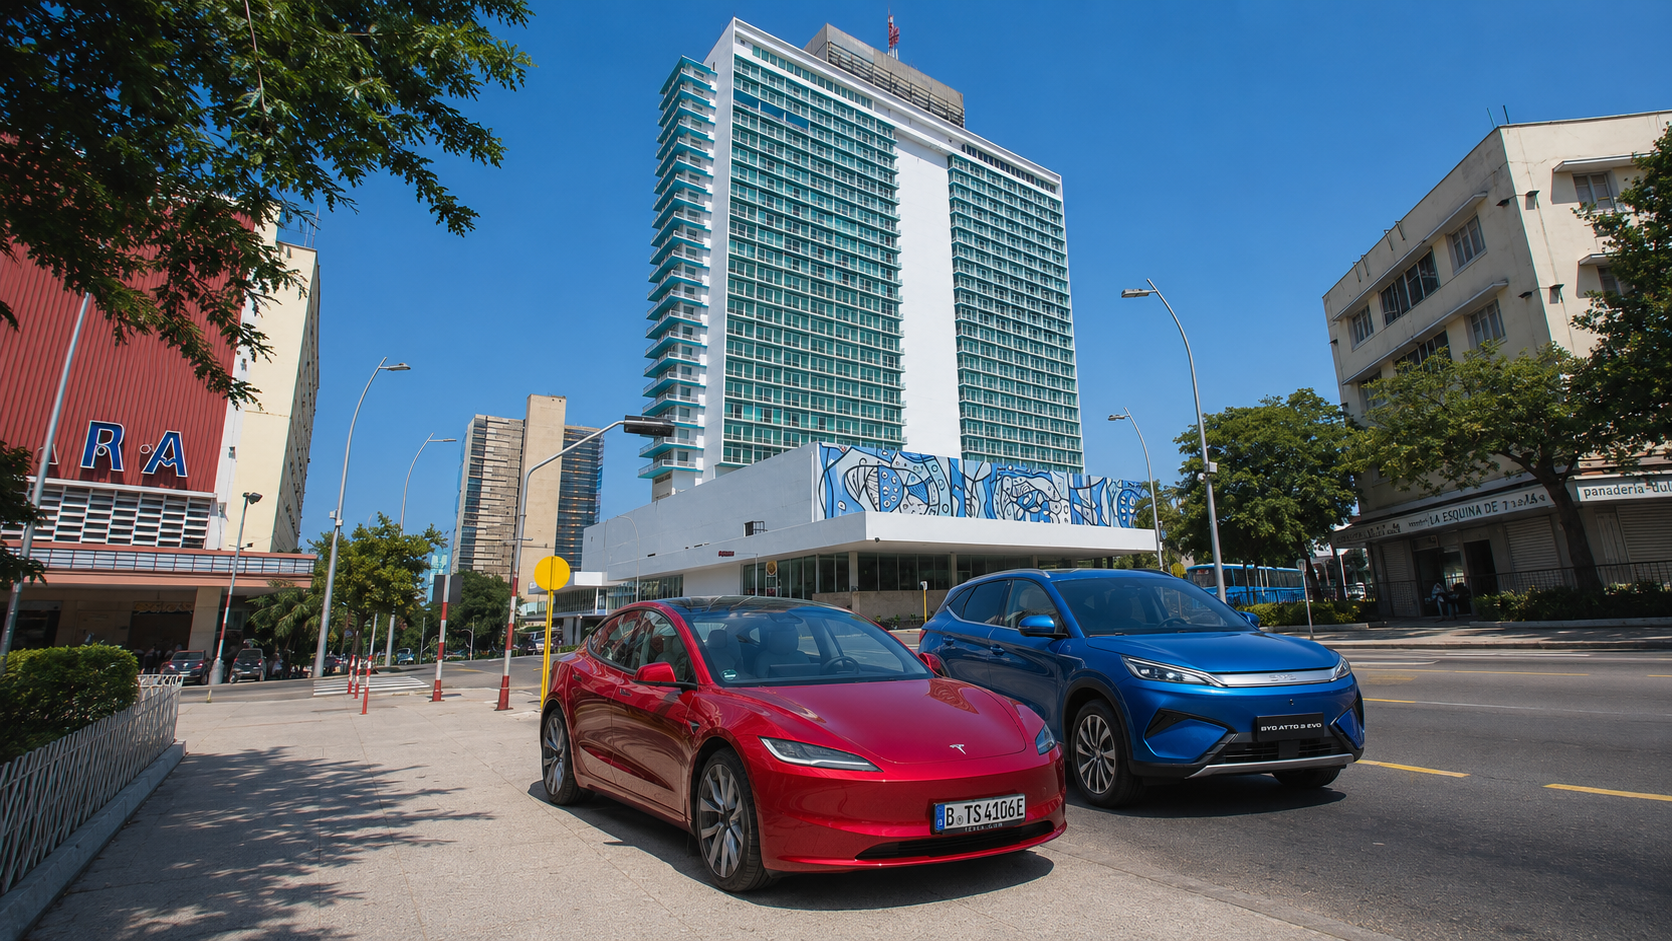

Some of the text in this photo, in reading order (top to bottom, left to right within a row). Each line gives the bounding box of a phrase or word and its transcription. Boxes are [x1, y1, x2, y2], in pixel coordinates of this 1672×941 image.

[1429, 515, 1440, 525] LA
[1442, 504, 1482, 522] ESQUINA
[1484, 500, 1498, 514] DE
[946, 807, 954, 826] B
